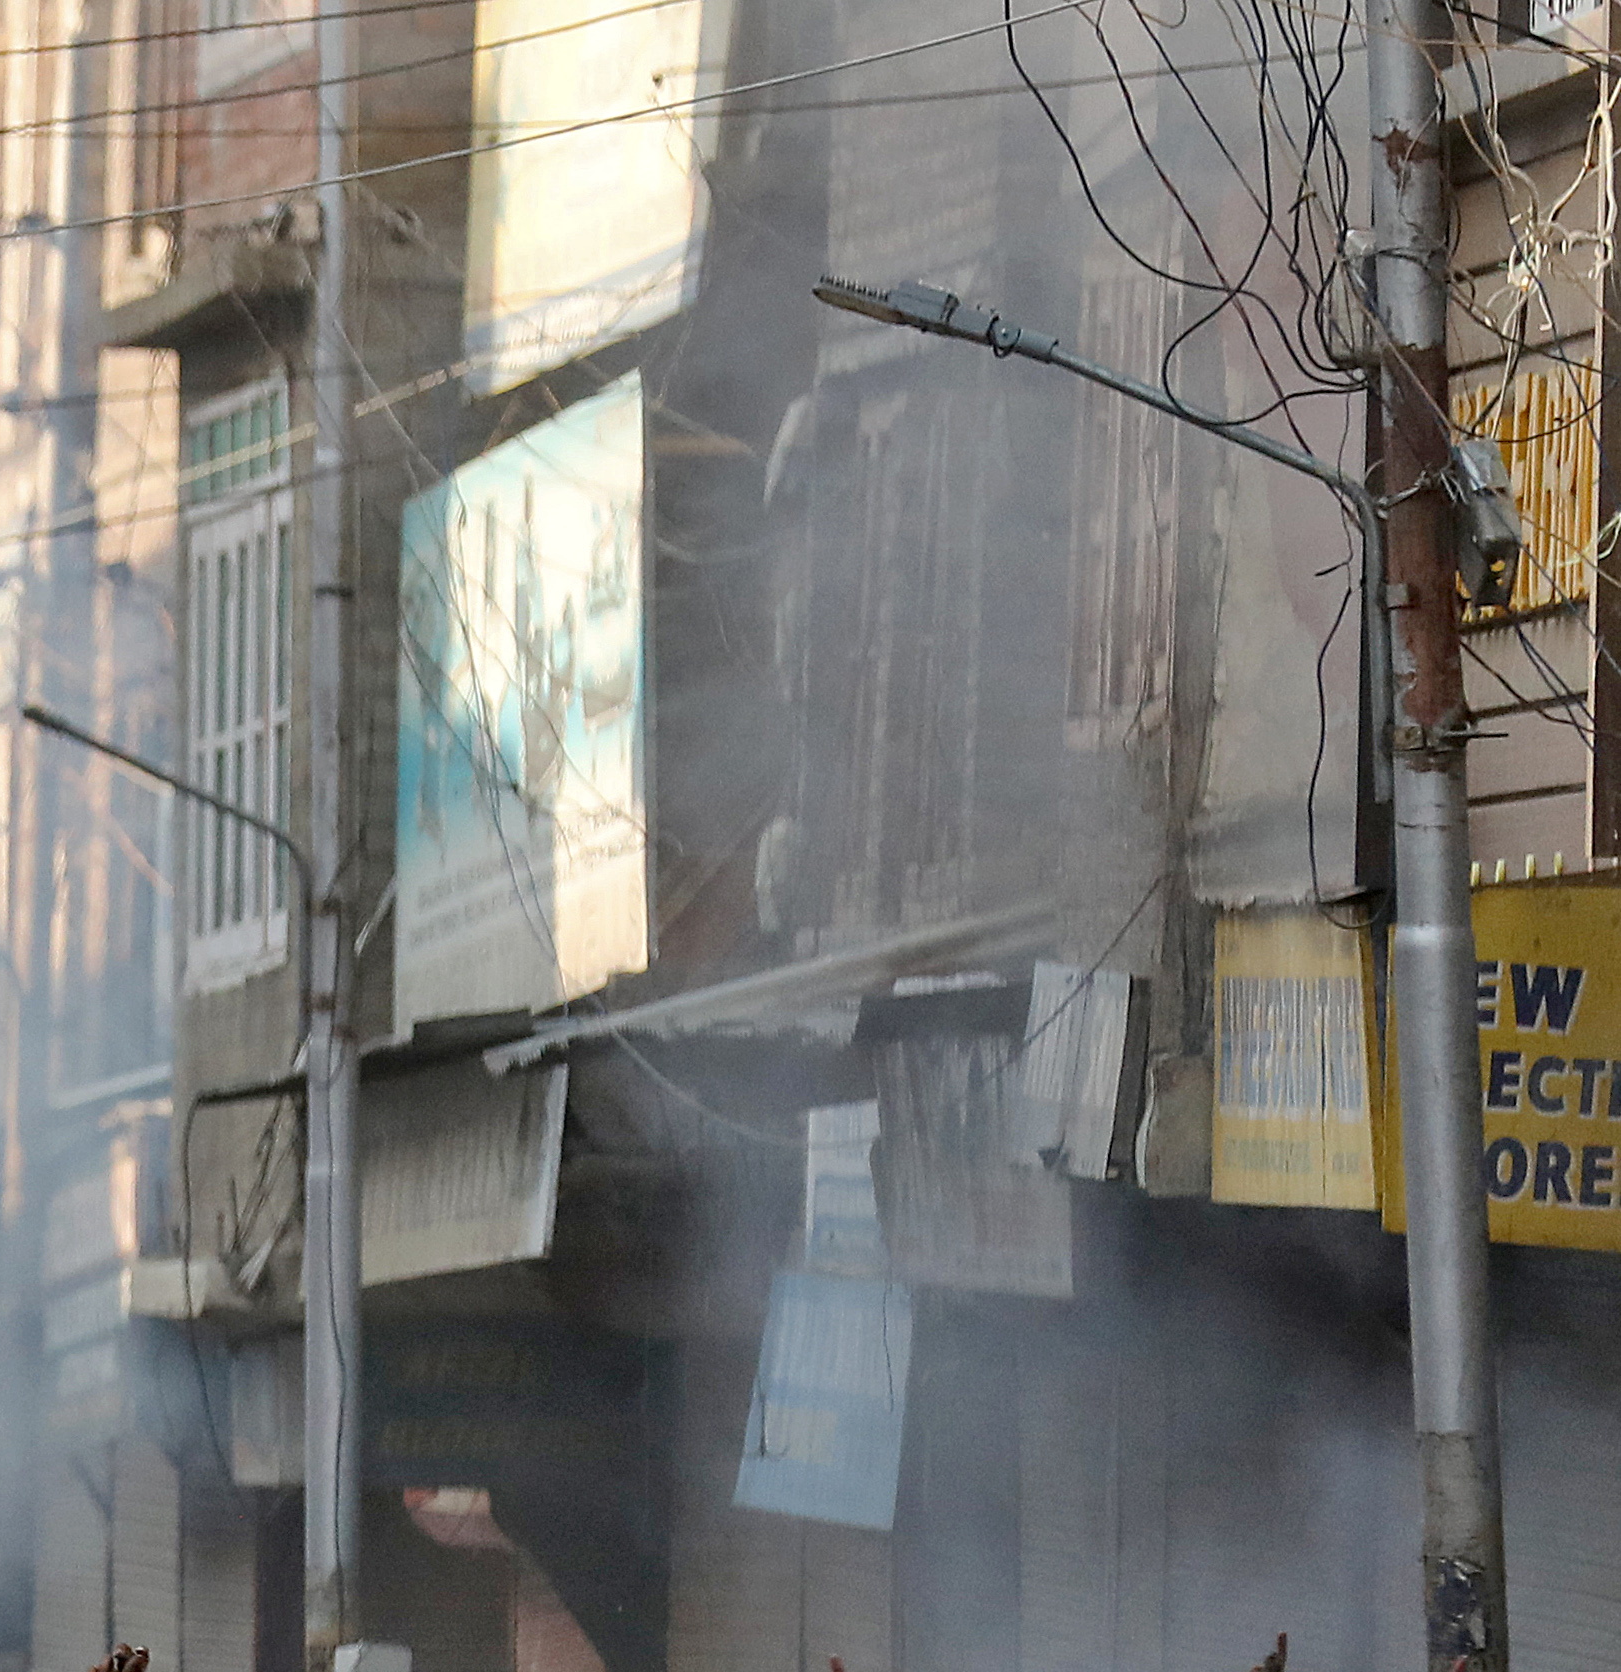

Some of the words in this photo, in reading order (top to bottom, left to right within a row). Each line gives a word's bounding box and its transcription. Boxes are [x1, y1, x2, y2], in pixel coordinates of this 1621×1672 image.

[1475, 960, 1587, 1034] EW
[1483, 1051, 1621, 1118] ECT
[1485, 1137, 1621, 1210] ORE
